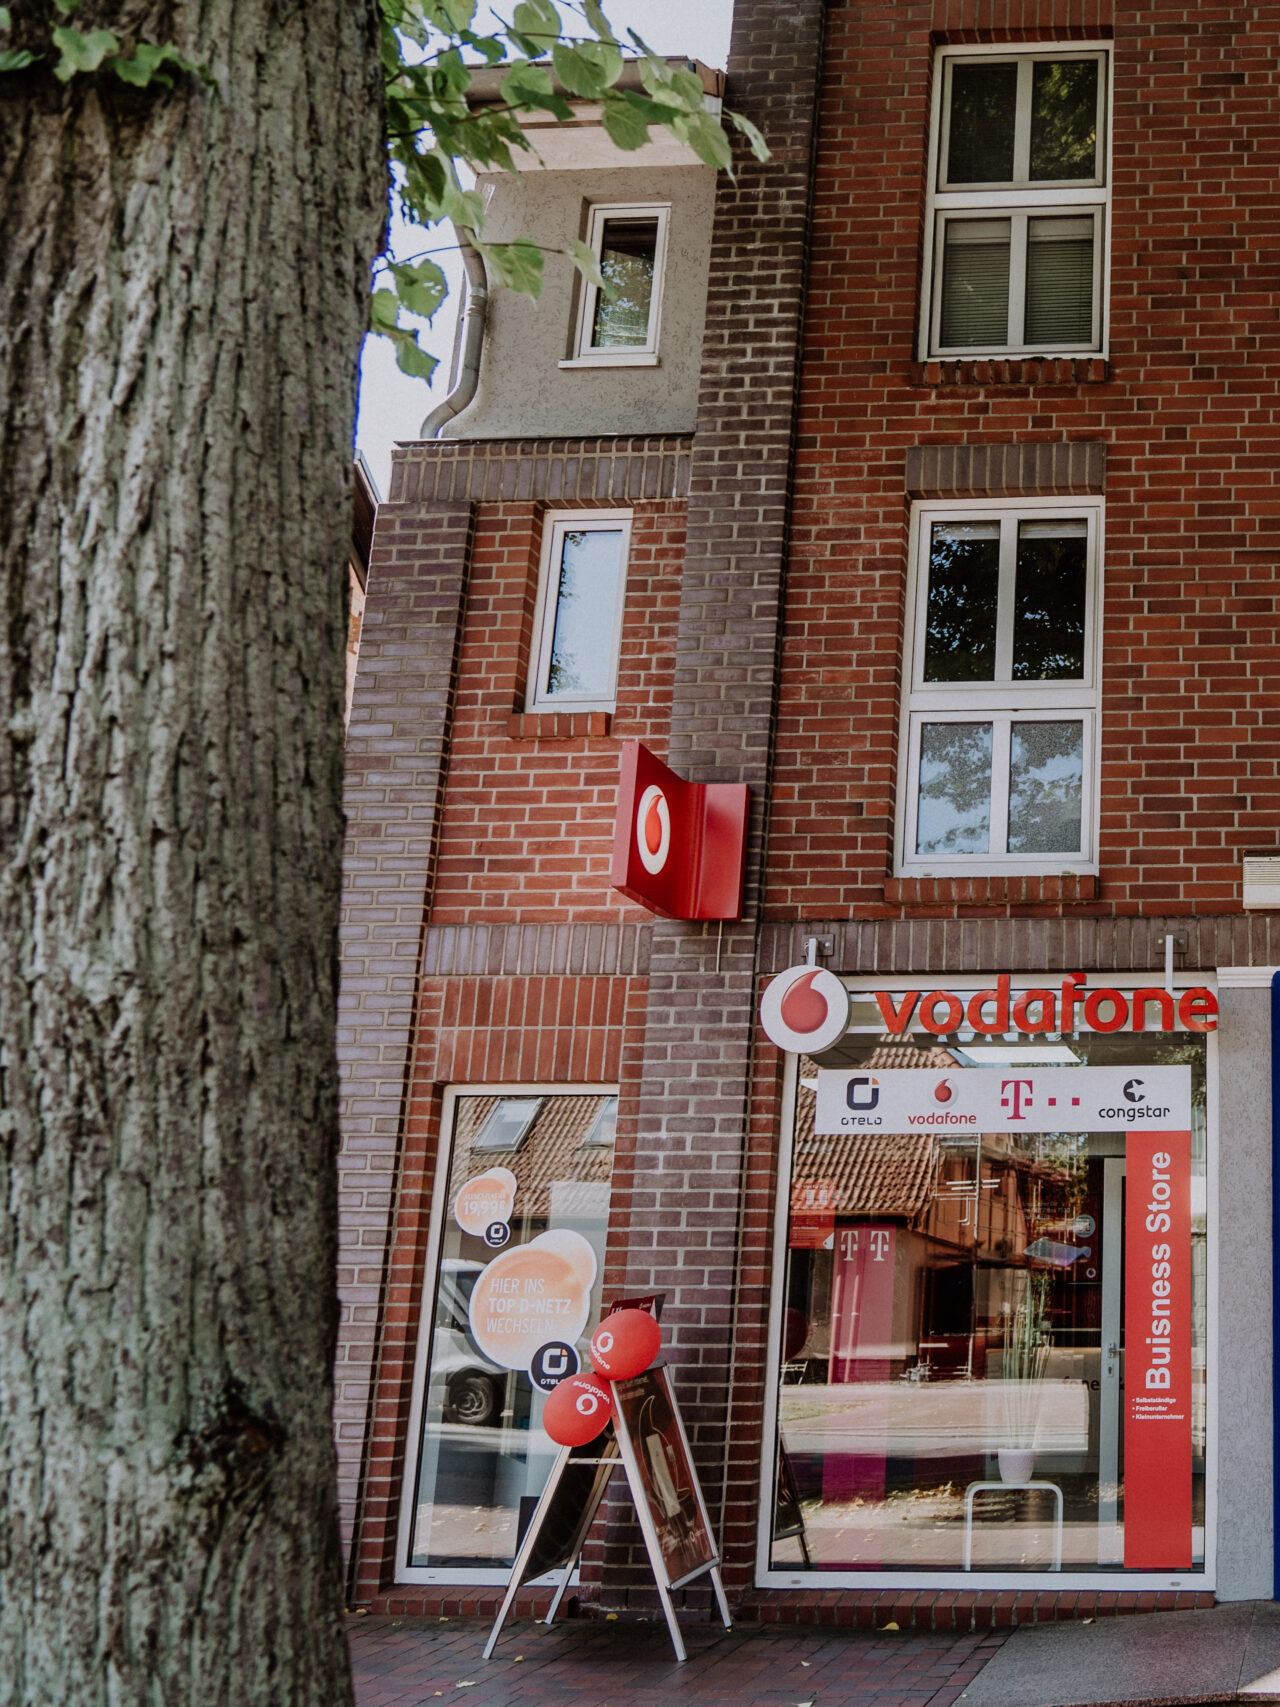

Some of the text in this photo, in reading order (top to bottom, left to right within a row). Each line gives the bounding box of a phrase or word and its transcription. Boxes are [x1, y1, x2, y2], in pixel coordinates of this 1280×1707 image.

[873, 973, 1219, 1035] vodafone
[908, 1111, 977, 1126] vodafone
[1098, 1105, 1171, 1123] congstar
[1145, 1151, 1171, 1390] Buisness Store
[489, 1278, 545, 1294] HIER INS
[488, 1298, 571, 1315] TOP D-NETZ
[486, 1317, 554, 1335] WECHSELN
